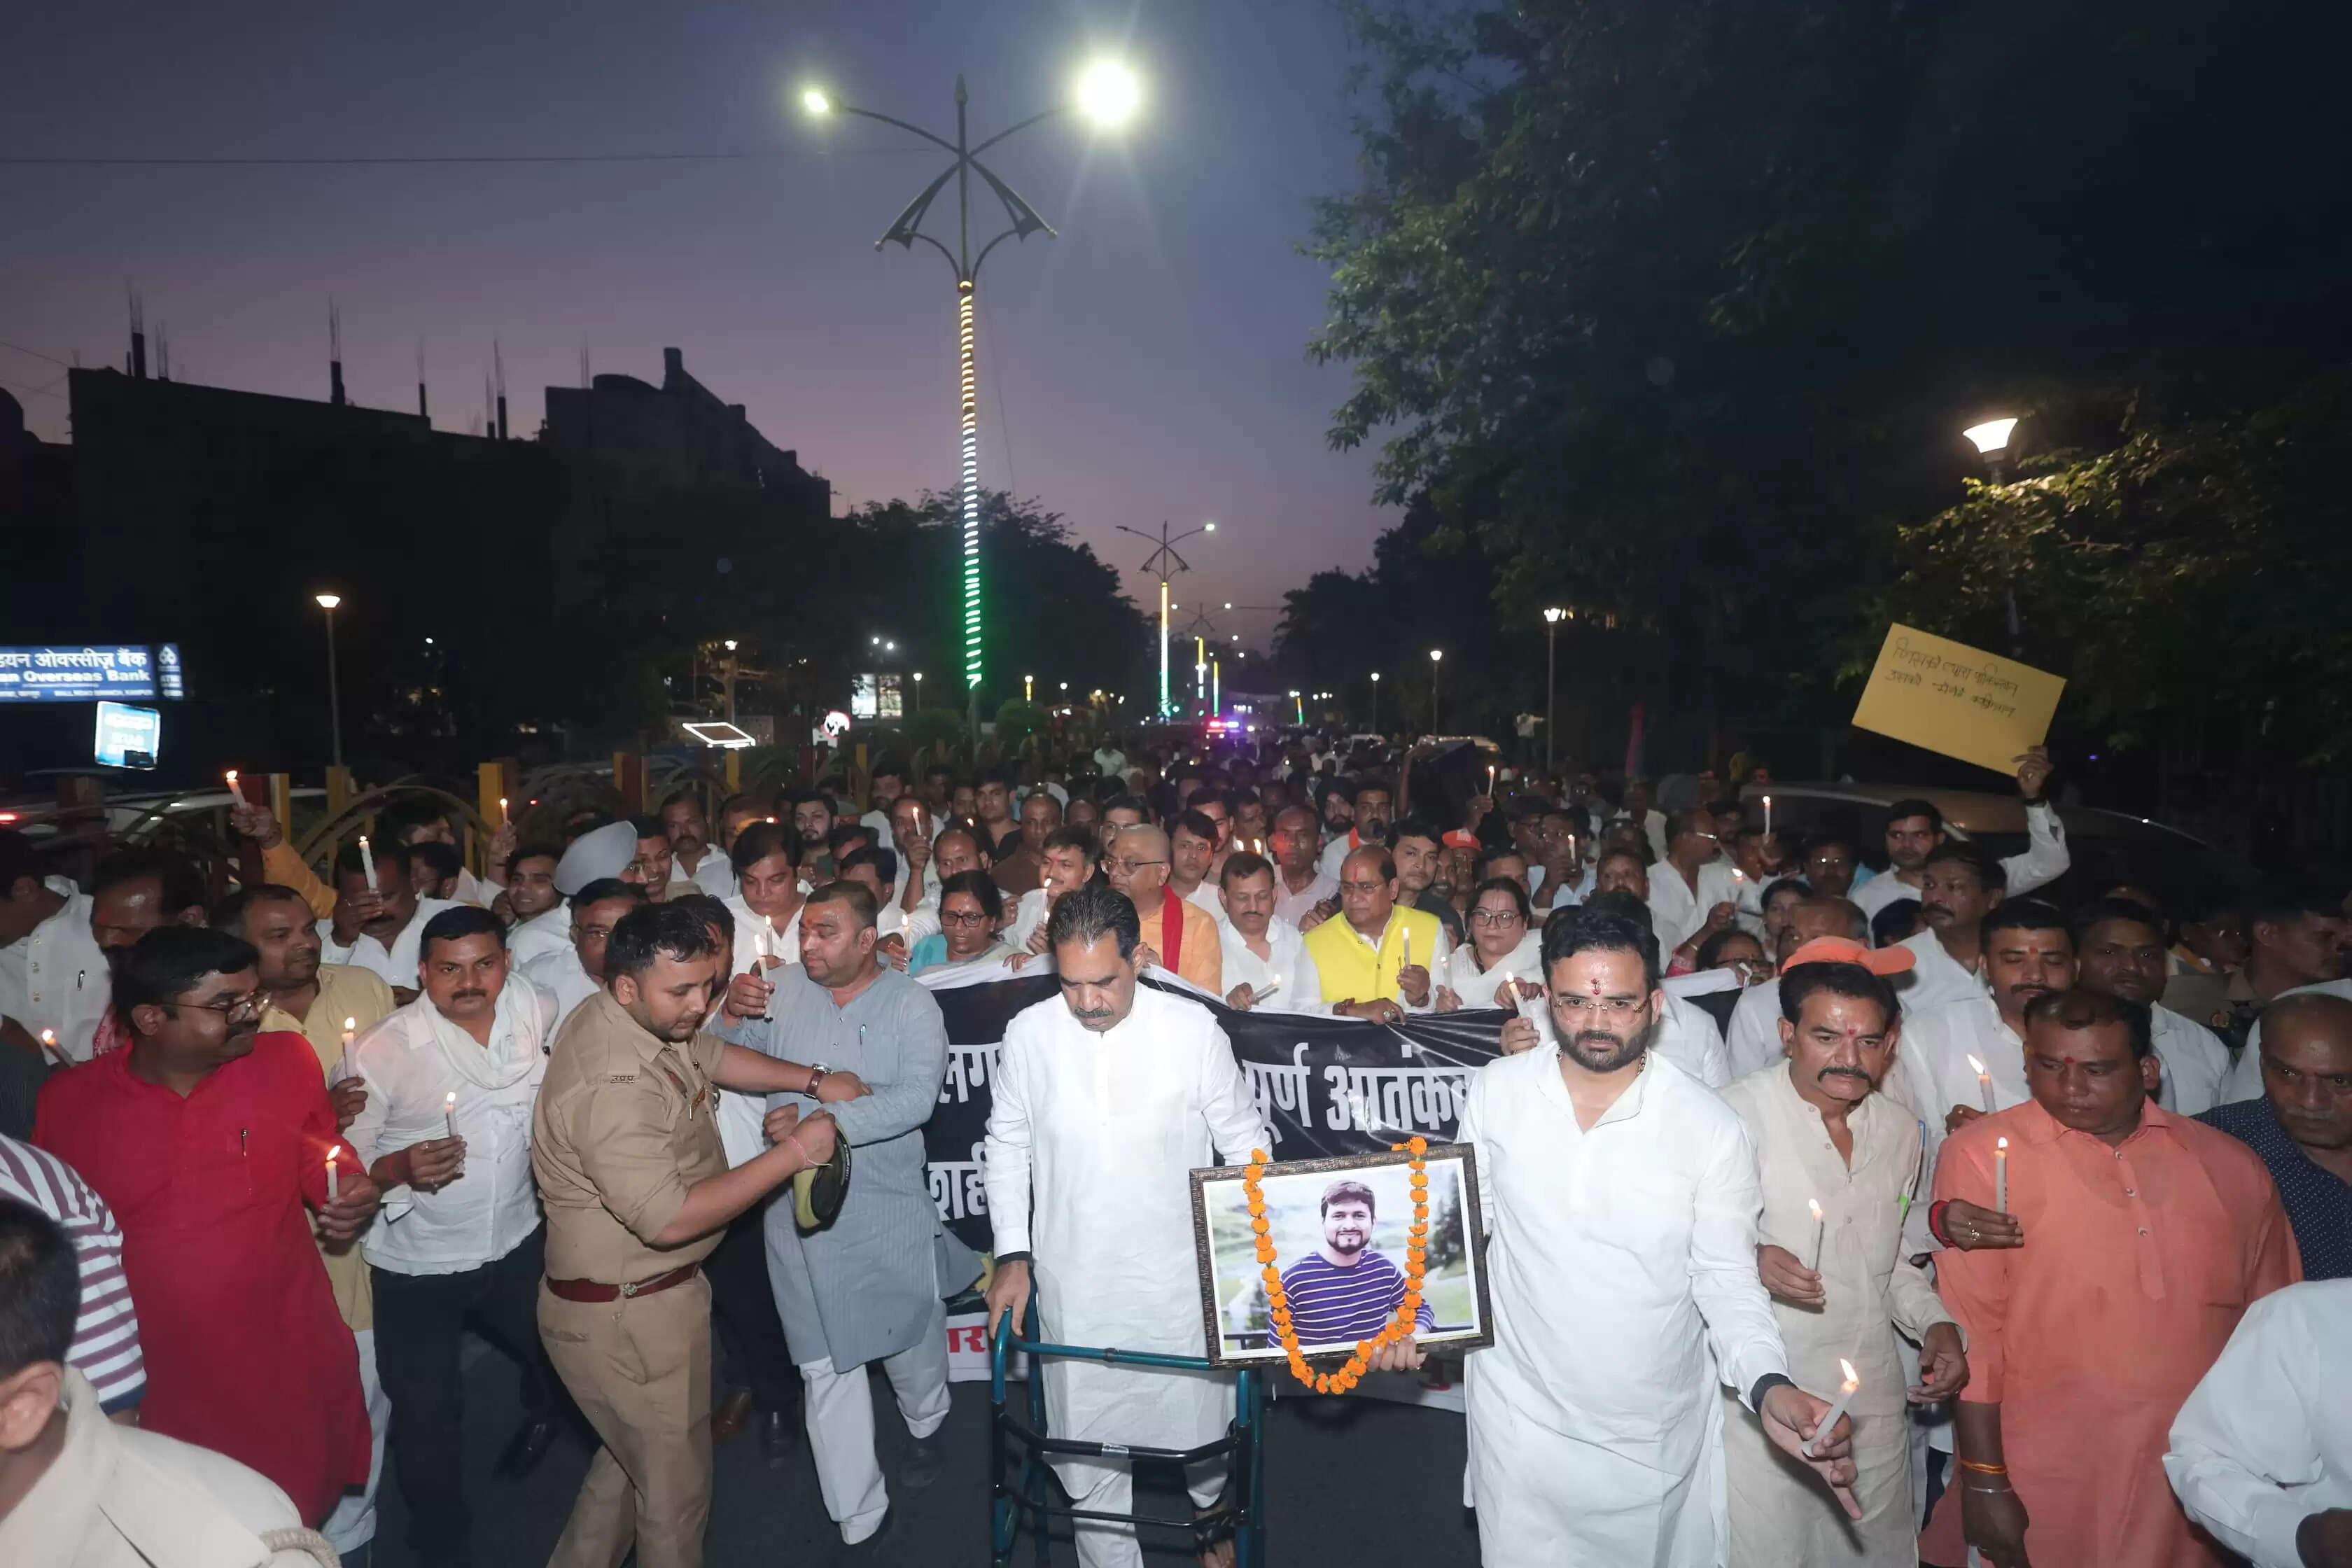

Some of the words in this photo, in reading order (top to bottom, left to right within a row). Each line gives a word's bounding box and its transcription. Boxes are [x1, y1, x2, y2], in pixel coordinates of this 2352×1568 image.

[0, 673, 20, 682] an
[23, 671, 104, 682] Overseas
[106, 669, 151, 682] Bank
